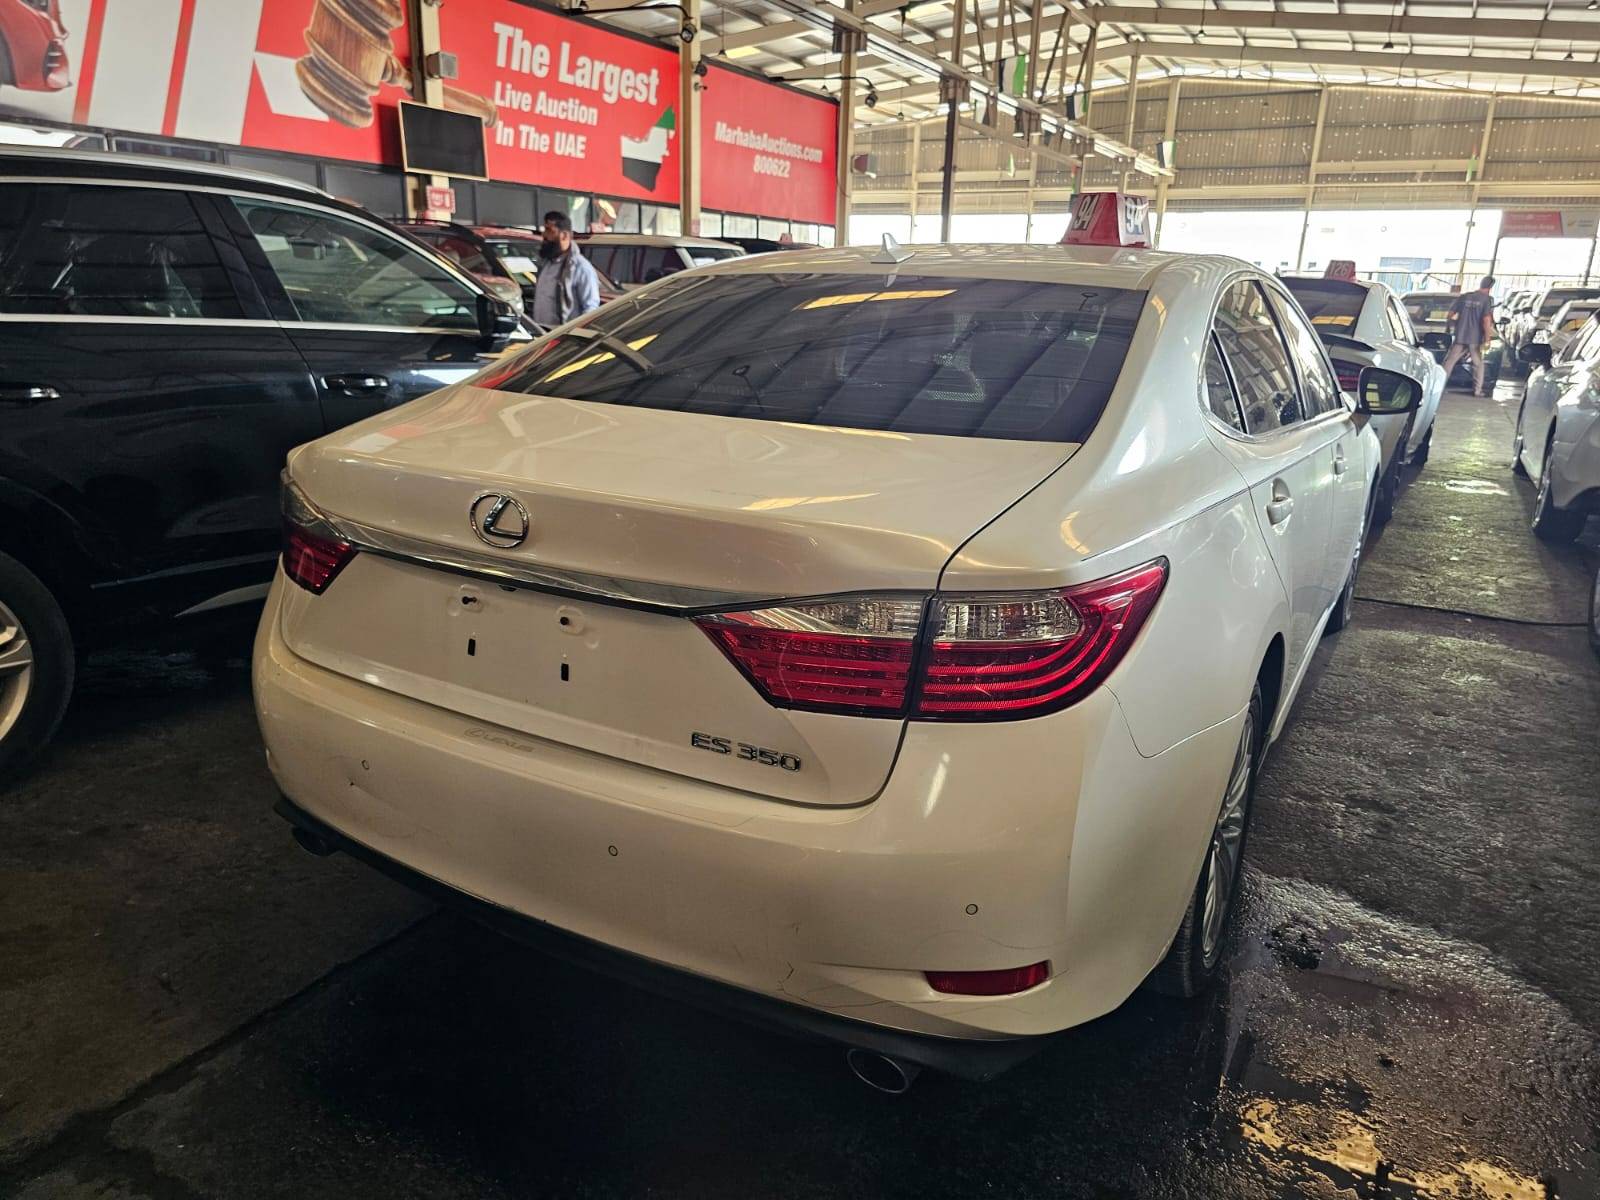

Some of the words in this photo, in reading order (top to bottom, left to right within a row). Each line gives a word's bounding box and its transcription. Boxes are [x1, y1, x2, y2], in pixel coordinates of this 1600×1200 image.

[493, 21, 551, 78] The
[558, 41, 660, 106] Largest
[494, 80, 532, 112] Live
[535, 90, 598, 126] Auction
[495, 120, 514, 147] In
[518, 124, 550, 153] The
[553, 130, 587, 159] UAE
[715, 120, 822, 163] MarhabaAuctions.com
[753, 154, 791, 178] 800622
[1073, 193, 1100, 231] 94
[1124, 196, 1149, 234] 94
[691, 731, 731, 755] ES
[737, 742, 801, 772] 350
